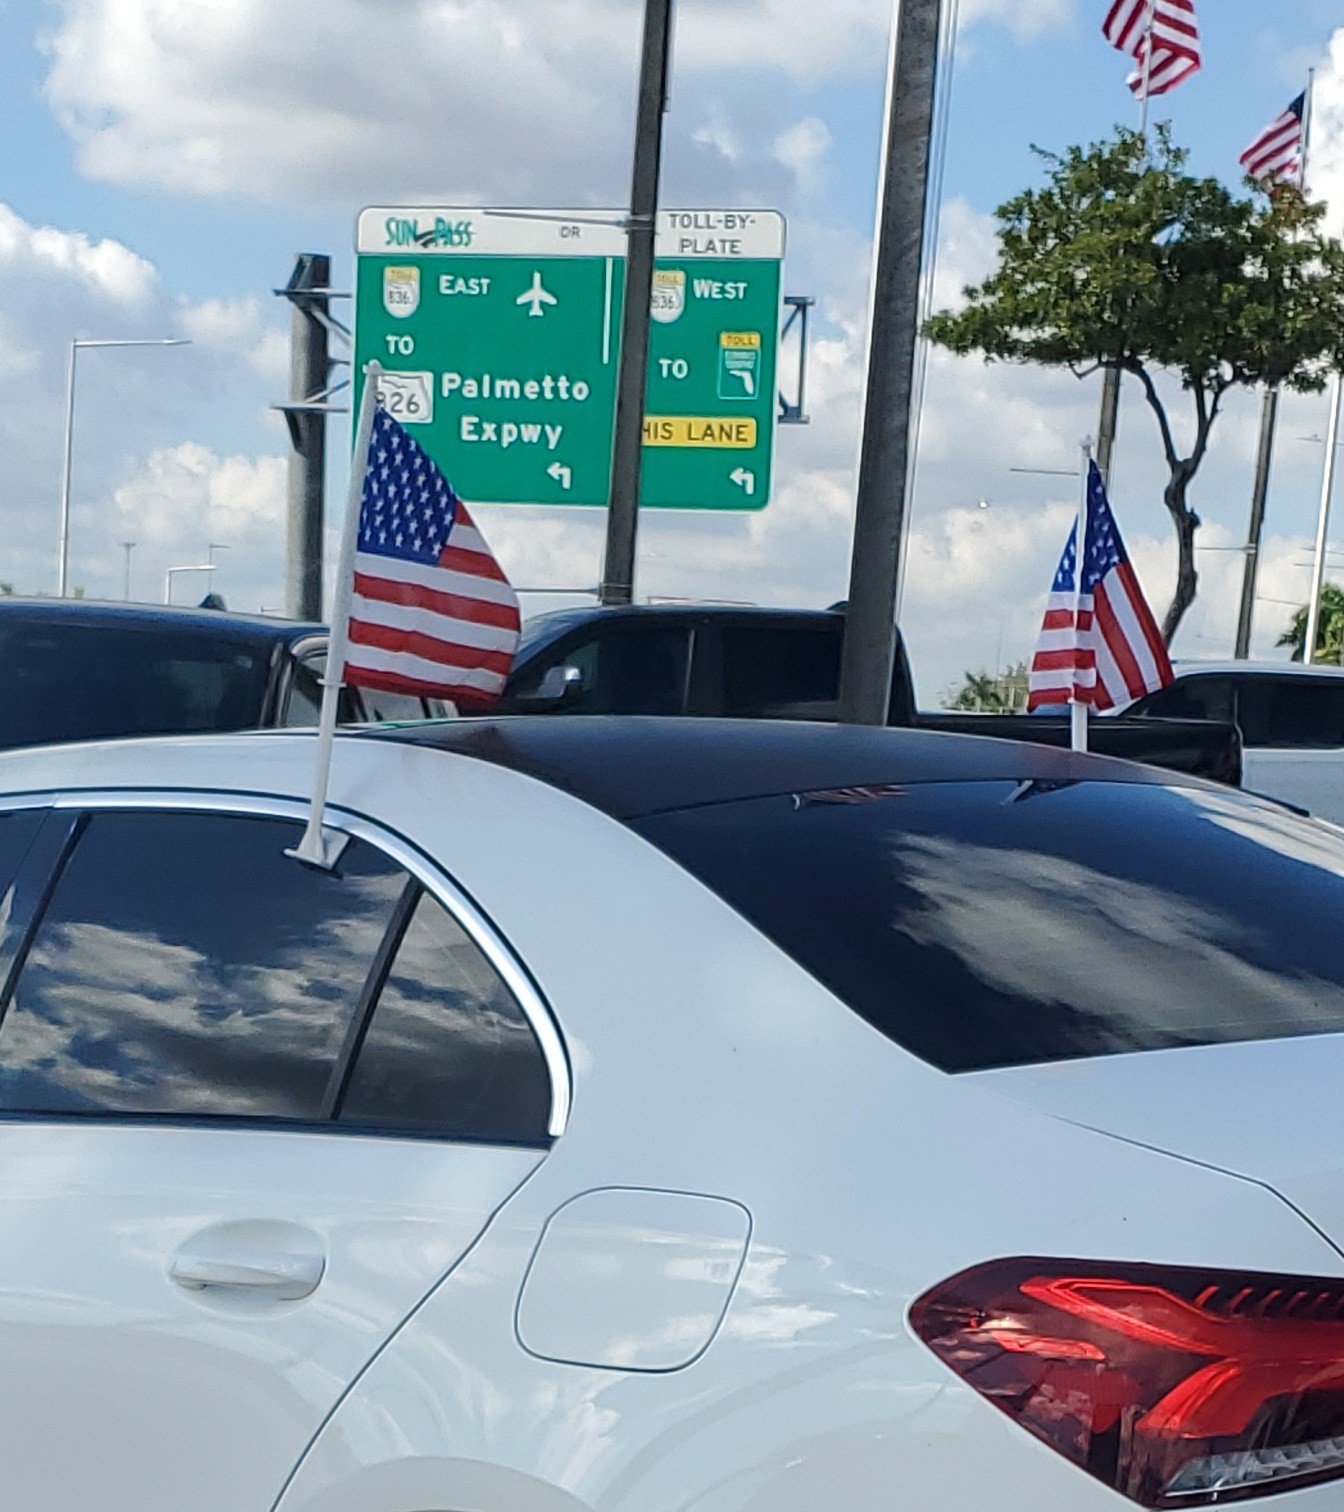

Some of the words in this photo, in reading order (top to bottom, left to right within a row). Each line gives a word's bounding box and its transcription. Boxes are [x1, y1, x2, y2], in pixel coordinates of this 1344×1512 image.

[669, 213, 756, 229] TOLL-BY-
[680, 239, 742, 254] PLATE
[439, 274, 491, 295] EAST
[693, 278, 748, 300] WEST
[386, 334, 414, 355] TO
[658, 358, 689, 379] TO
[441, 372, 589, 401] Palmetto
[460, 415, 562, 449] Expwy
[642, 422, 674, 440] HIS
[687, 423, 749, 442] LANE
